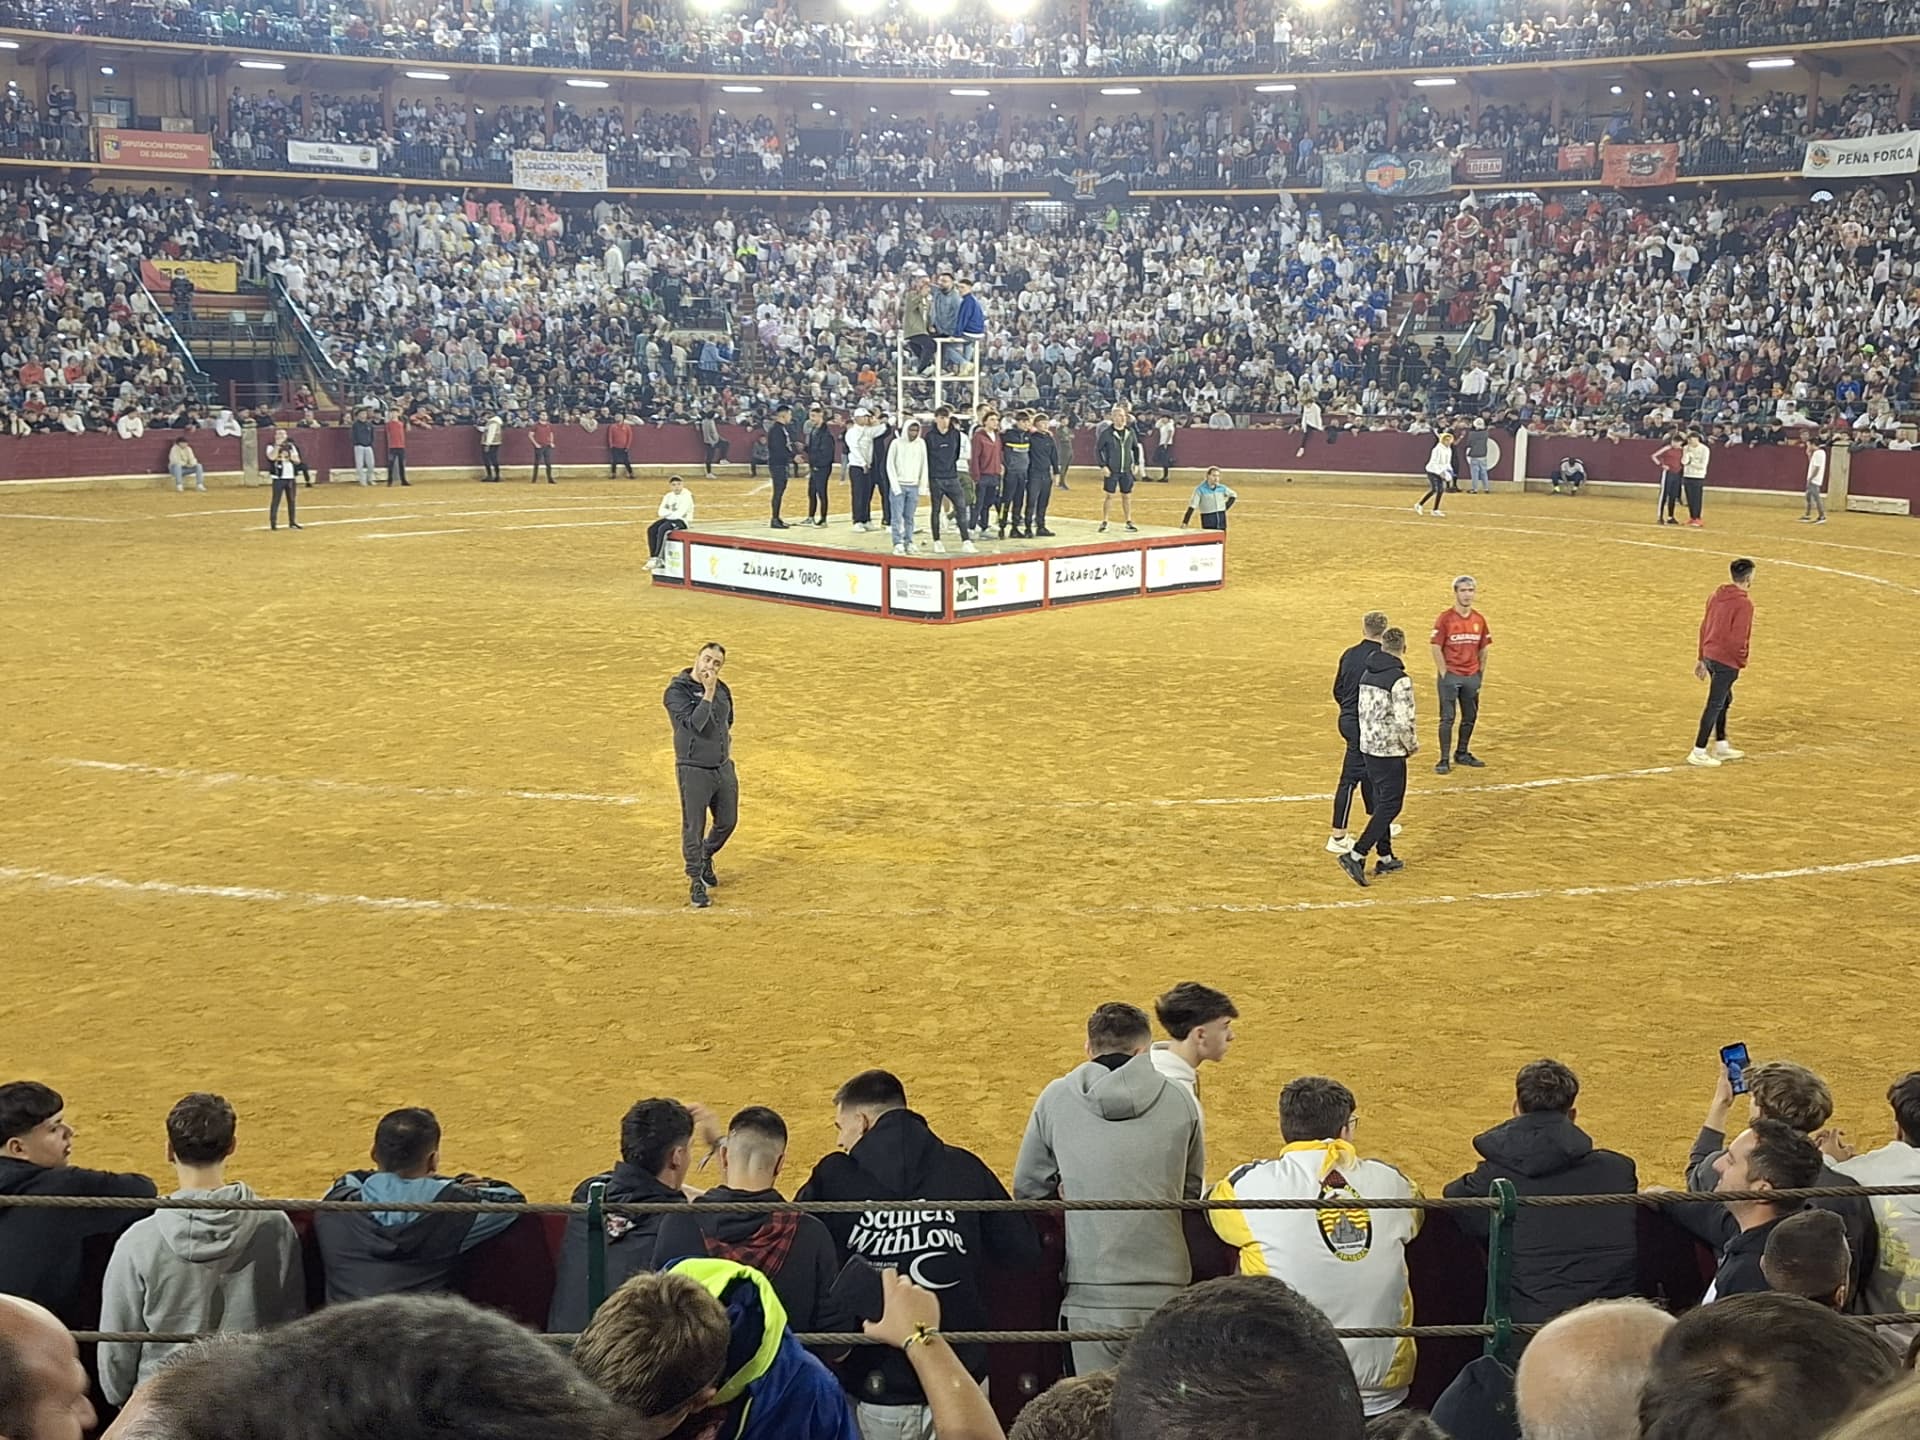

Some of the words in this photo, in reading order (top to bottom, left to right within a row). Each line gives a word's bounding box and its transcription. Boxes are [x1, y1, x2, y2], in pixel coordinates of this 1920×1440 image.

[151, 151, 188, 159] ZARAGOZA
[1837, 152, 1869, 165] PEÑA
[1873, 147, 1913, 163] FORCA
[743, 562, 794, 581] ZARAGOZA
[798, 568, 823, 587] TOROS
[1055, 566, 1108, 583] ZARAGOZA
[1112, 564, 1135, 579] TOROS
